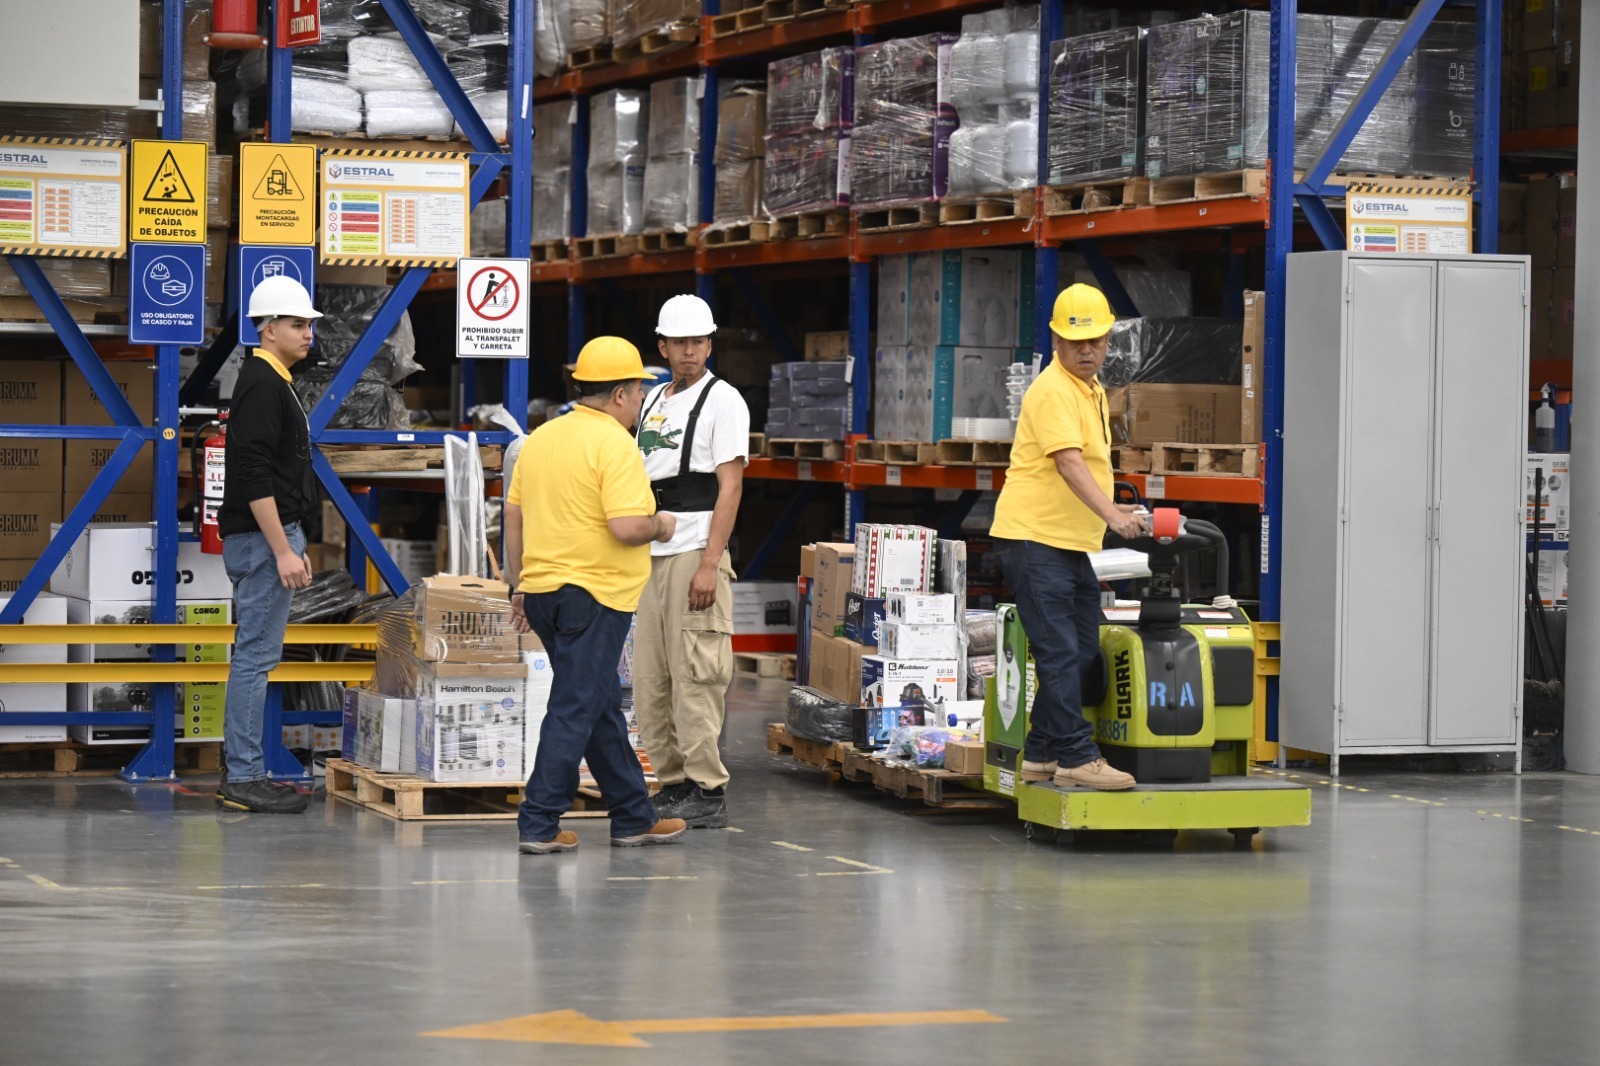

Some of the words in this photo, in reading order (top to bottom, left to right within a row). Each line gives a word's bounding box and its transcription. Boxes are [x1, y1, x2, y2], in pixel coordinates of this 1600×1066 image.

[0, 153, 48, 164] STRAL
[343, 166, 395, 177] ESTRAL
[138, 206, 198, 216] PRECAUCIÓN
[1365, 202, 1409, 212] ESTRAL
[154, 217, 182, 226] CAÍDA
[154, 228, 197, 237] OBJETOS
[131, 569, 194, 585] CGO
[193, 607, 220, 615] CONGO
[440, 610, 504, 637] BRUMM
[440, 685, 484, 693] Hamilton
[485, 685, 516, 693] Beach
[1114, 649, 1132, 719] CLARK
[1150, 681, 1166, 707] R
[1179, 682, 1195, 707] A
